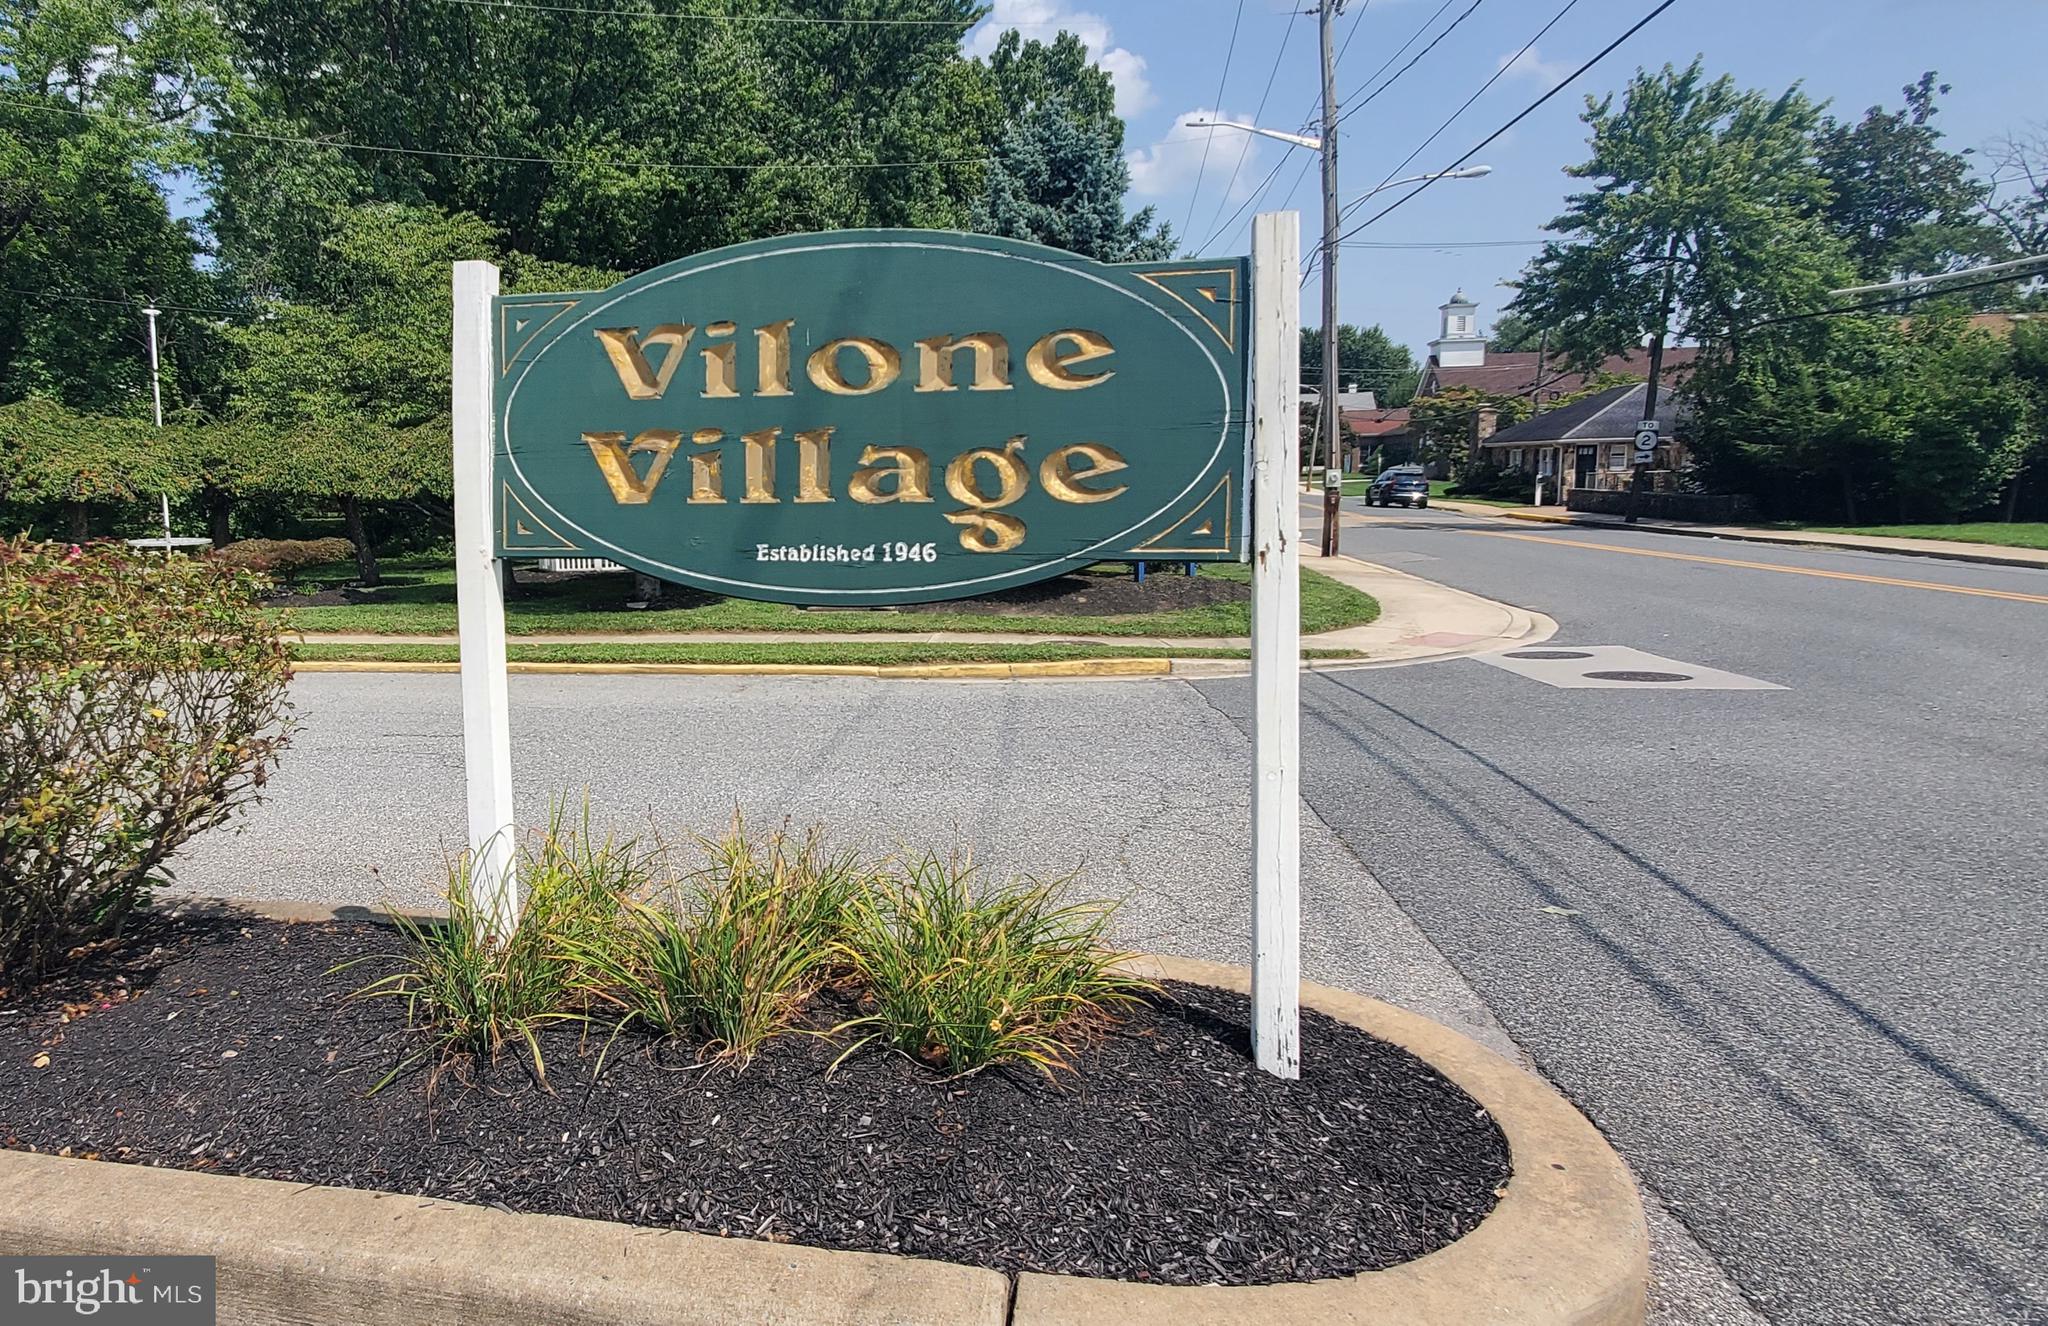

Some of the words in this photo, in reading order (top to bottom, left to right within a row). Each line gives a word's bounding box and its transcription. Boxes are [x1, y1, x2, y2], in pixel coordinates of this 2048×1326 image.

[593, 317, 1117, 399] Vilone
[1641, 434, 1651, 446] 2
[581, 425, 1130, 553] Village
[756, 543, 876, 563] Established
[881, 543, 937, 562] 1946
